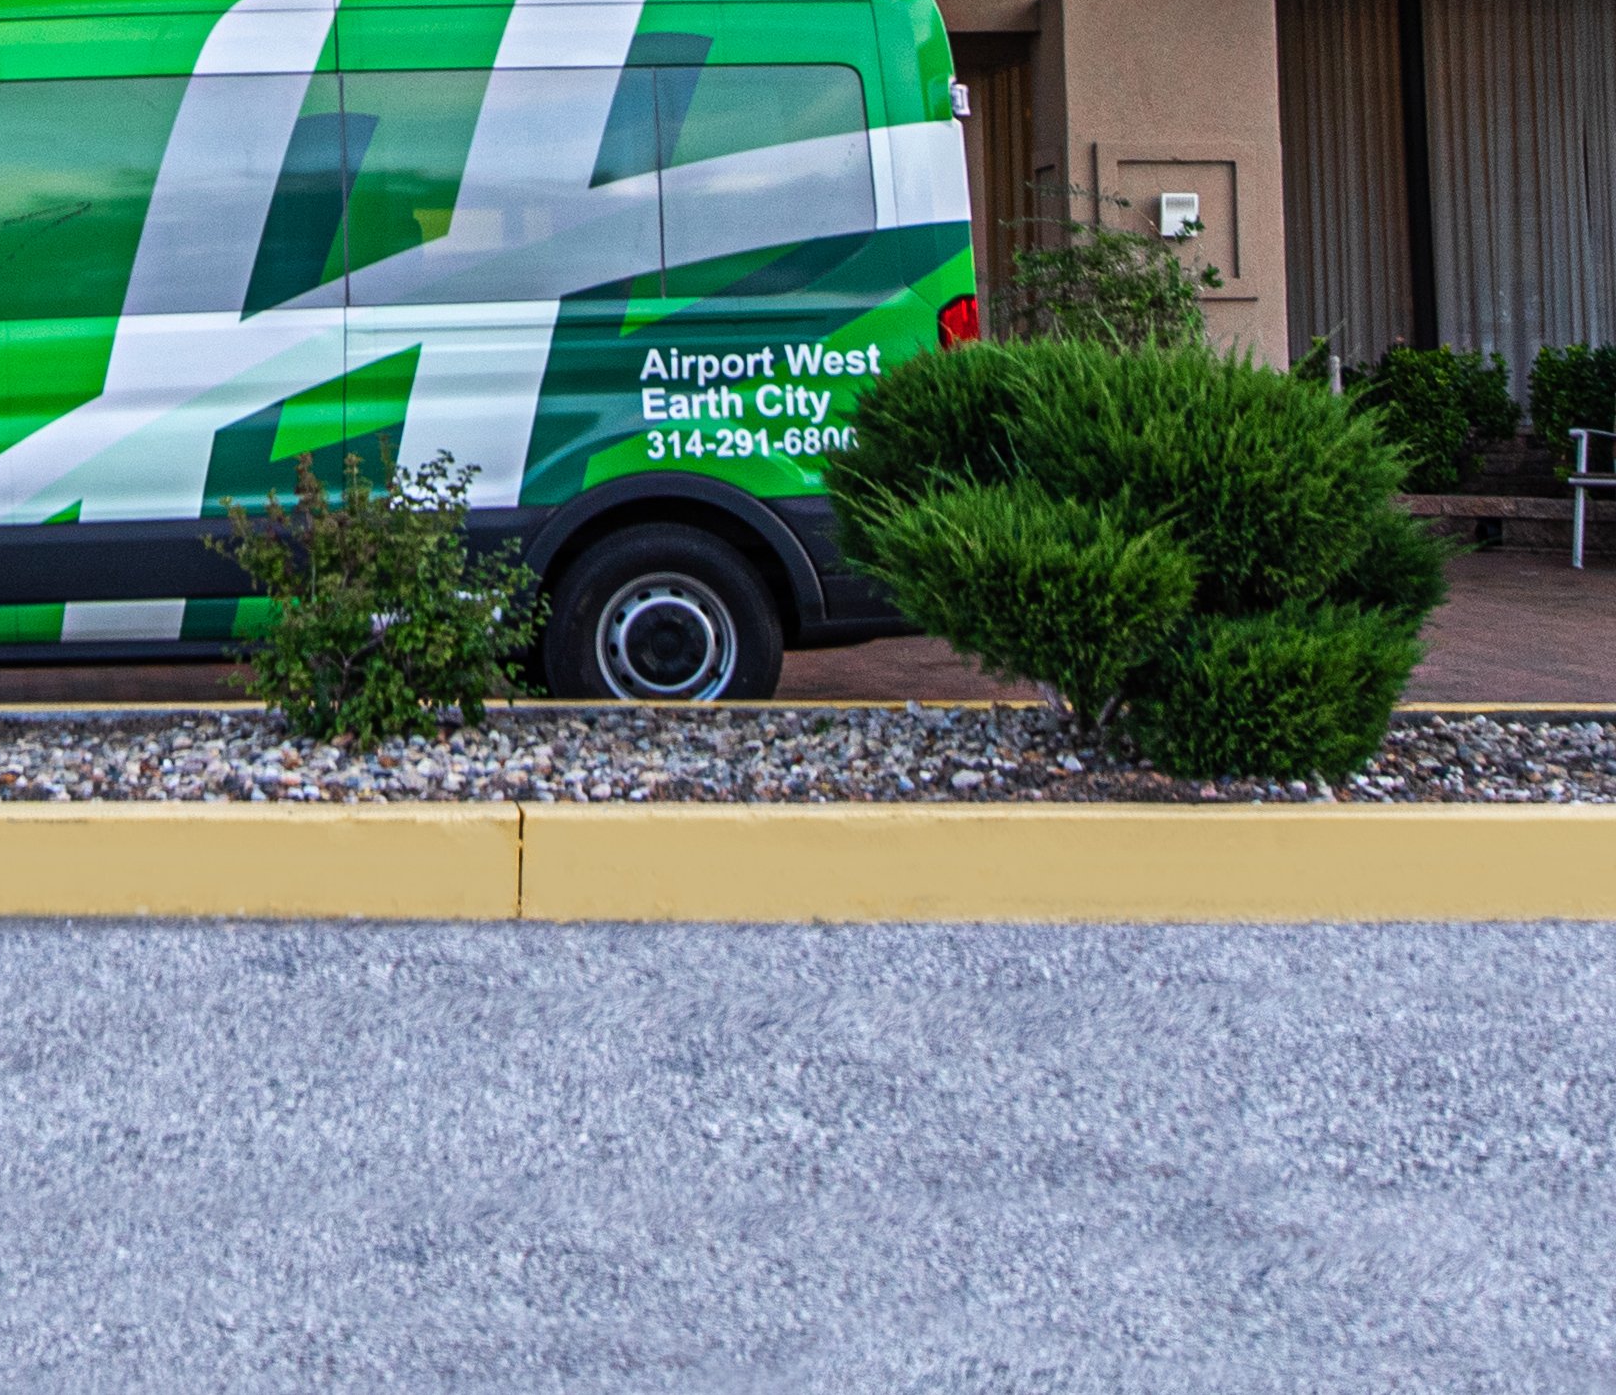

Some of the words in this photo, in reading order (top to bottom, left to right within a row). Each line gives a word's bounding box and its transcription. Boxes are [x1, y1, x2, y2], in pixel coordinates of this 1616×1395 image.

[639, 346, 774, 386] Airport
[785, 343, 881, 377] West
[641, 384, 744, 420] Earth
[756, 384, 831, 423] City
